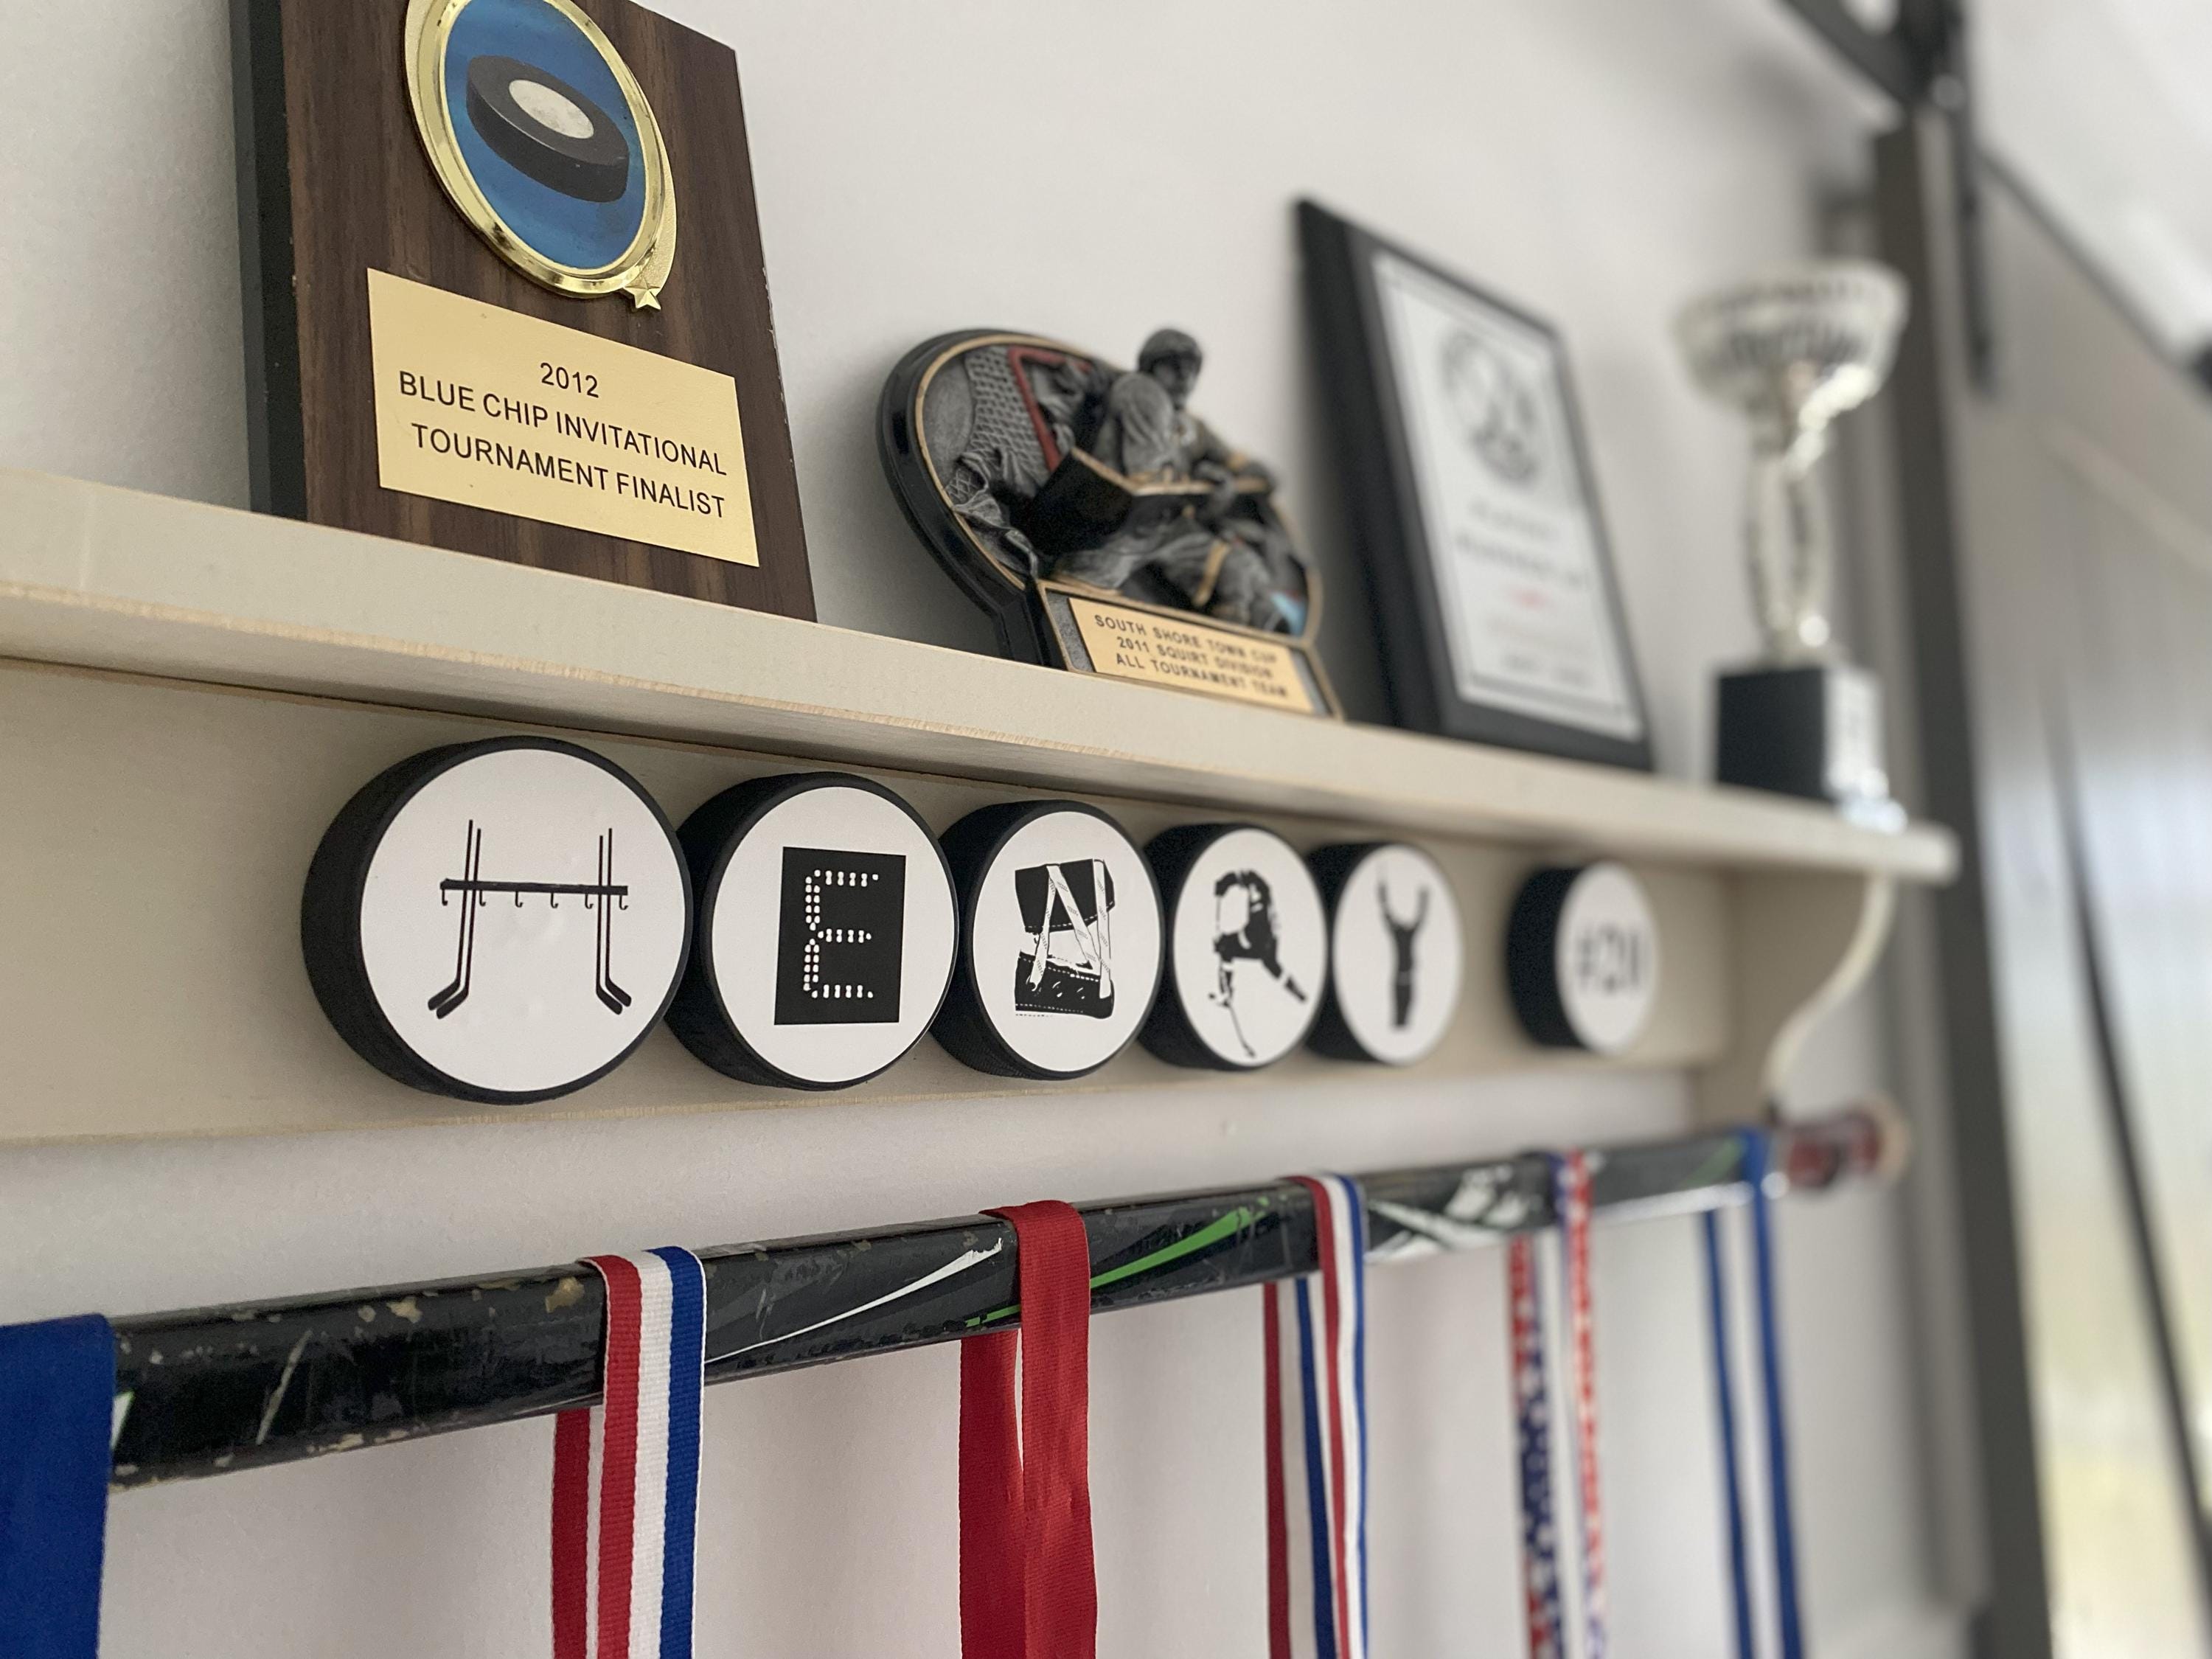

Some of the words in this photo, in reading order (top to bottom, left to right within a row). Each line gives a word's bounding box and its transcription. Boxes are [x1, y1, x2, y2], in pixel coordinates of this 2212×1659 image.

[540, 362, 599, 398] 2012
[399, 370, 476, 412] BLUE
[483, 393, 549, 430] CHIP
[556, 411, 727, 476] INVITATIONAL
[411, 423, 608, 490] TOURNAMENT
[616, 473, 725, 518] FINALIST
[1094, 614, 1147, 636] SOUTH
[1153, 627, 1201, 647] SHORE
[1207, 639, 1246, 658] TOWN
[1251, 651, 1278, 664] CUP
[1116, 636, 1150, 653] 2011
[1156, 644, 1209, 665] SQUIRT
[1215, 655, 1273, 678] DIVISION
[1116, 653, 1146, 669] ALL
[1151, 659, 1248, 688] TOURNAMENT
[1252, 676, 1288, 697] TEAM
